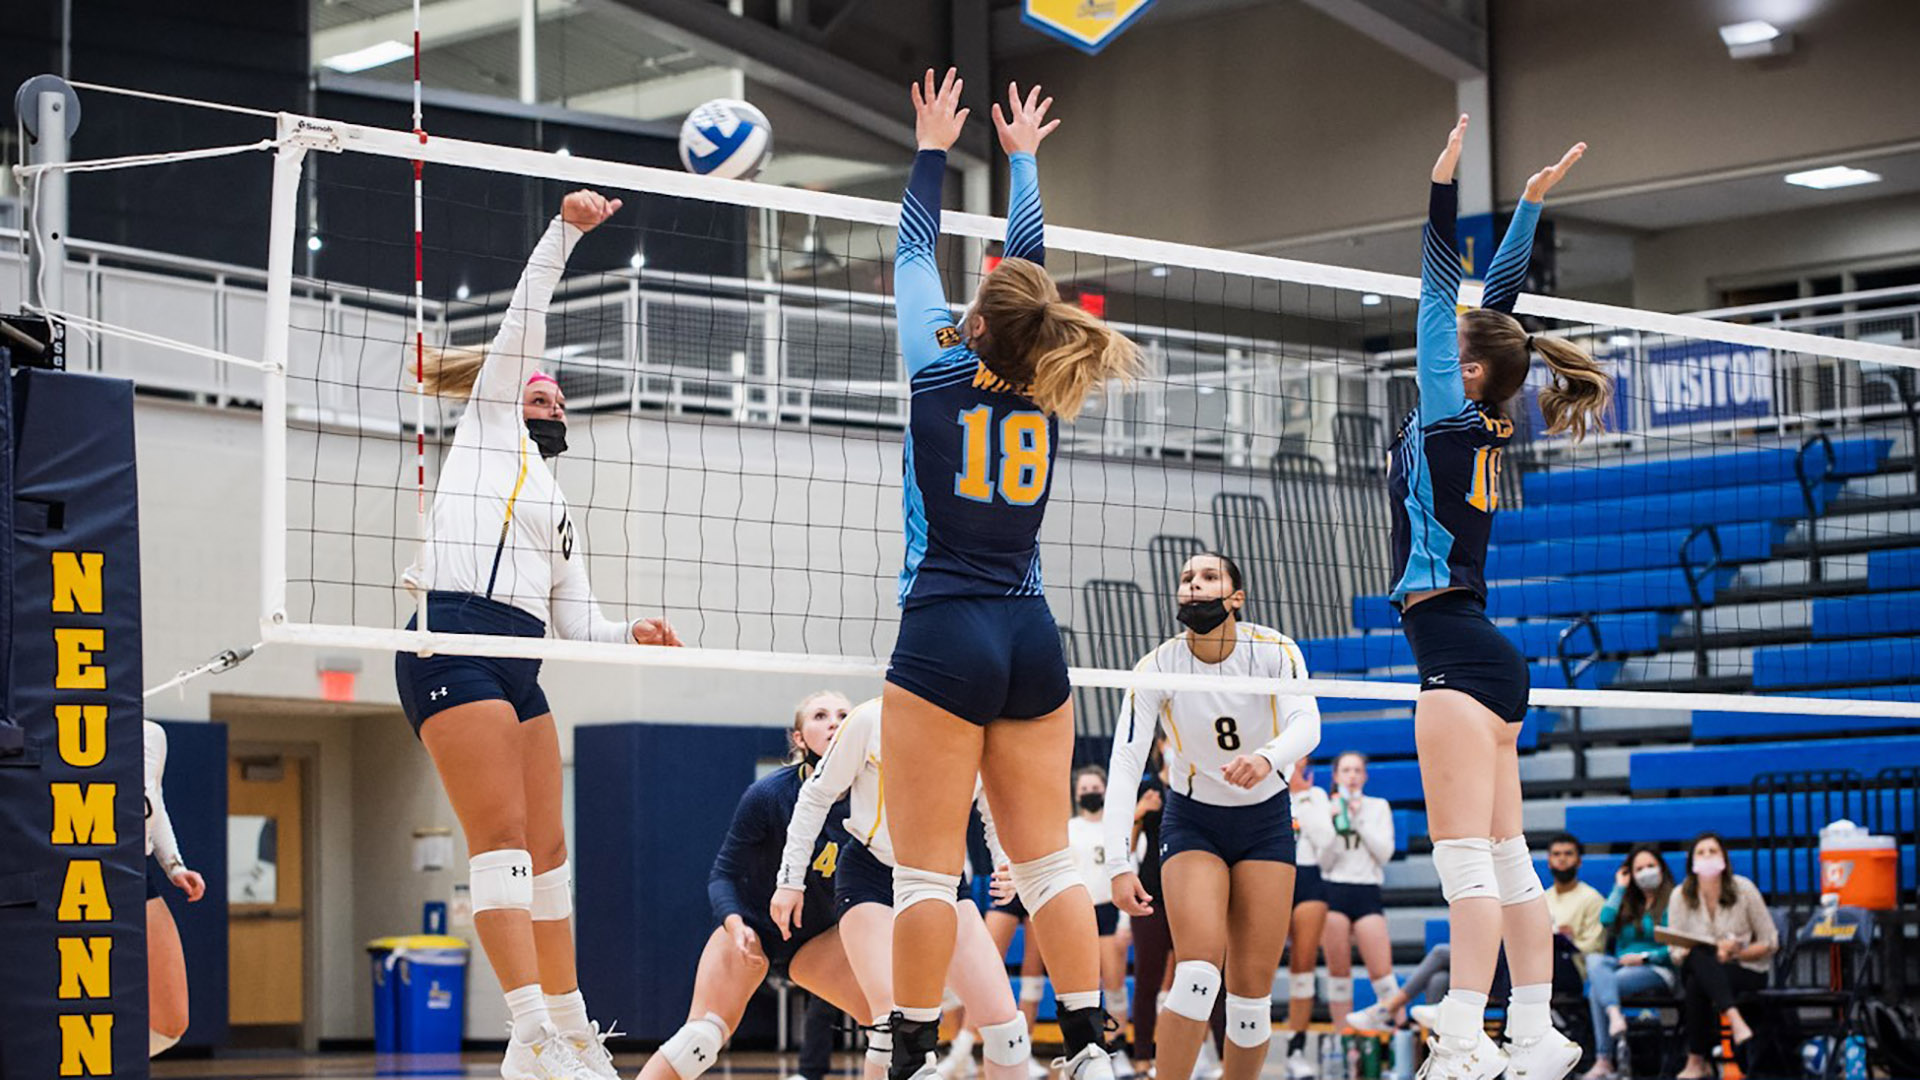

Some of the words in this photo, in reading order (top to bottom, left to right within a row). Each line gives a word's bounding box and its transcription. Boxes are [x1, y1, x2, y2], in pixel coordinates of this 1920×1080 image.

[305, 121, 333, 133] Senoh
[1650, 349, 1772, 414] VISITOR
[954, 403, 1050, 506] 18
[1214, 716, 1241, 751] 8
[50, 550, 118, 1077] NEUMANN
[812, 841, 839, 878] 4
[1093, 846, 1106, 865] 3
